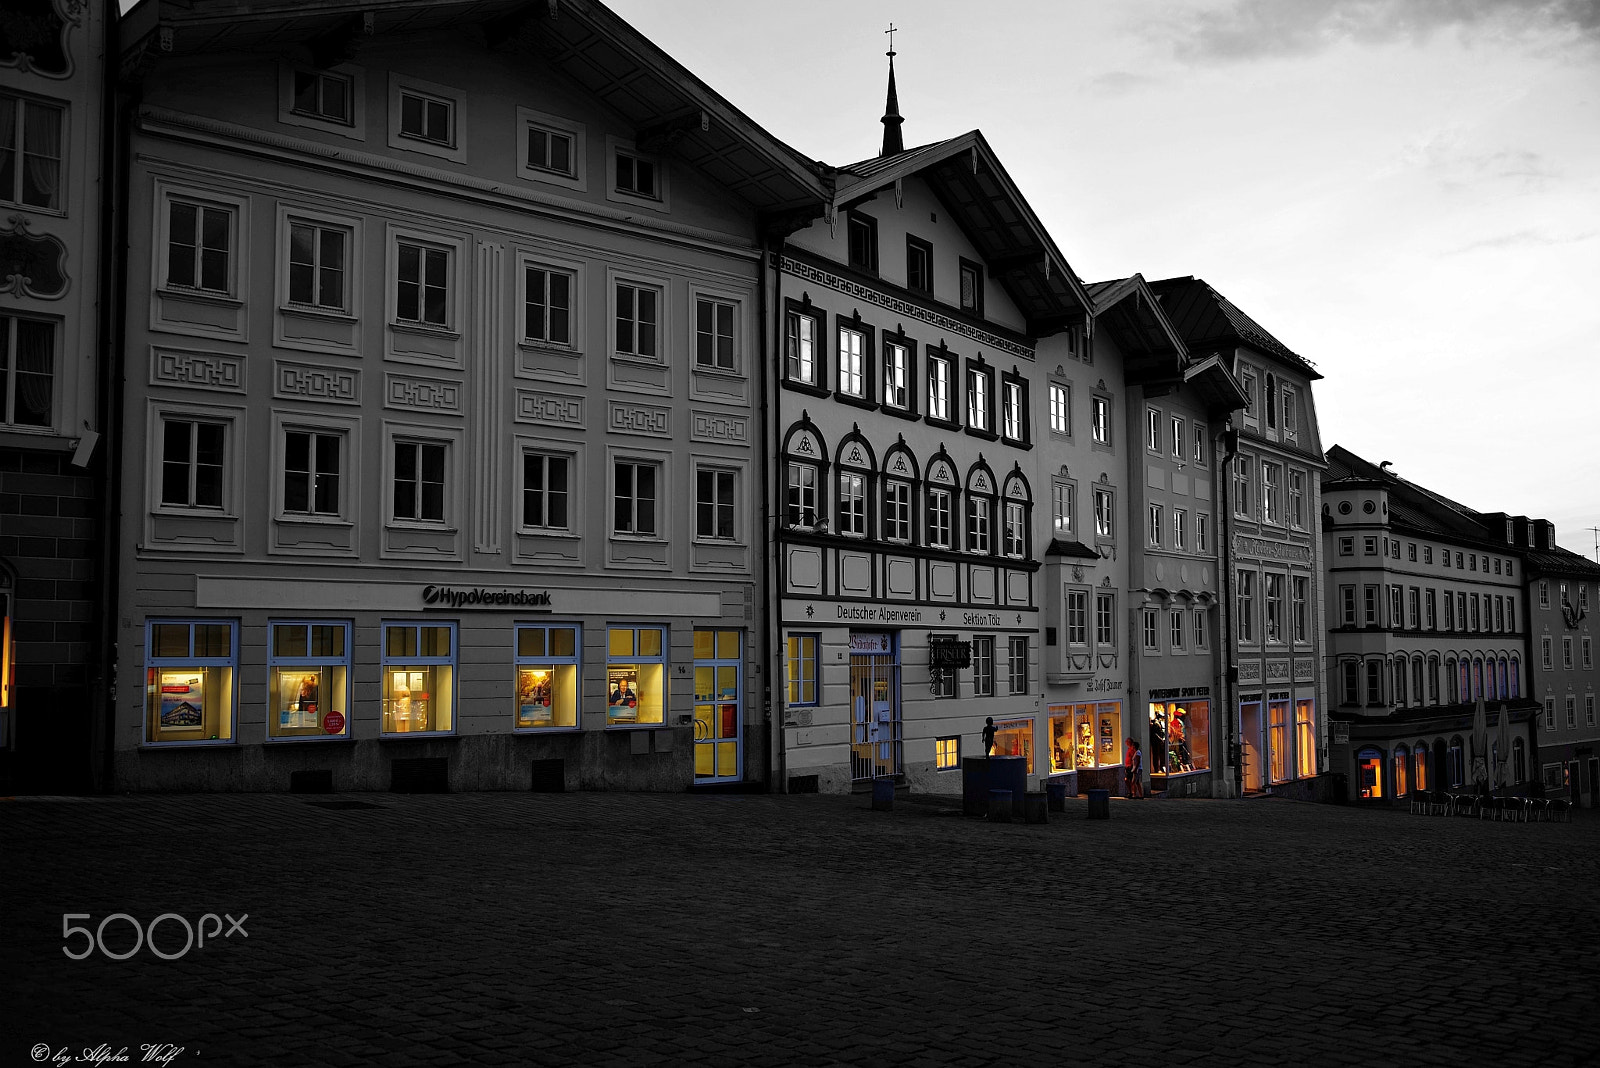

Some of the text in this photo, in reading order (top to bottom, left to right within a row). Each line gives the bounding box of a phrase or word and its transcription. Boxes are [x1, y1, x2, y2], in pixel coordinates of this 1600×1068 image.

[440, 587, 551, 607] HypoVereinsbank
[837, 605, 1001, 626] Deutscher Alpenverein Sektion Tölz
